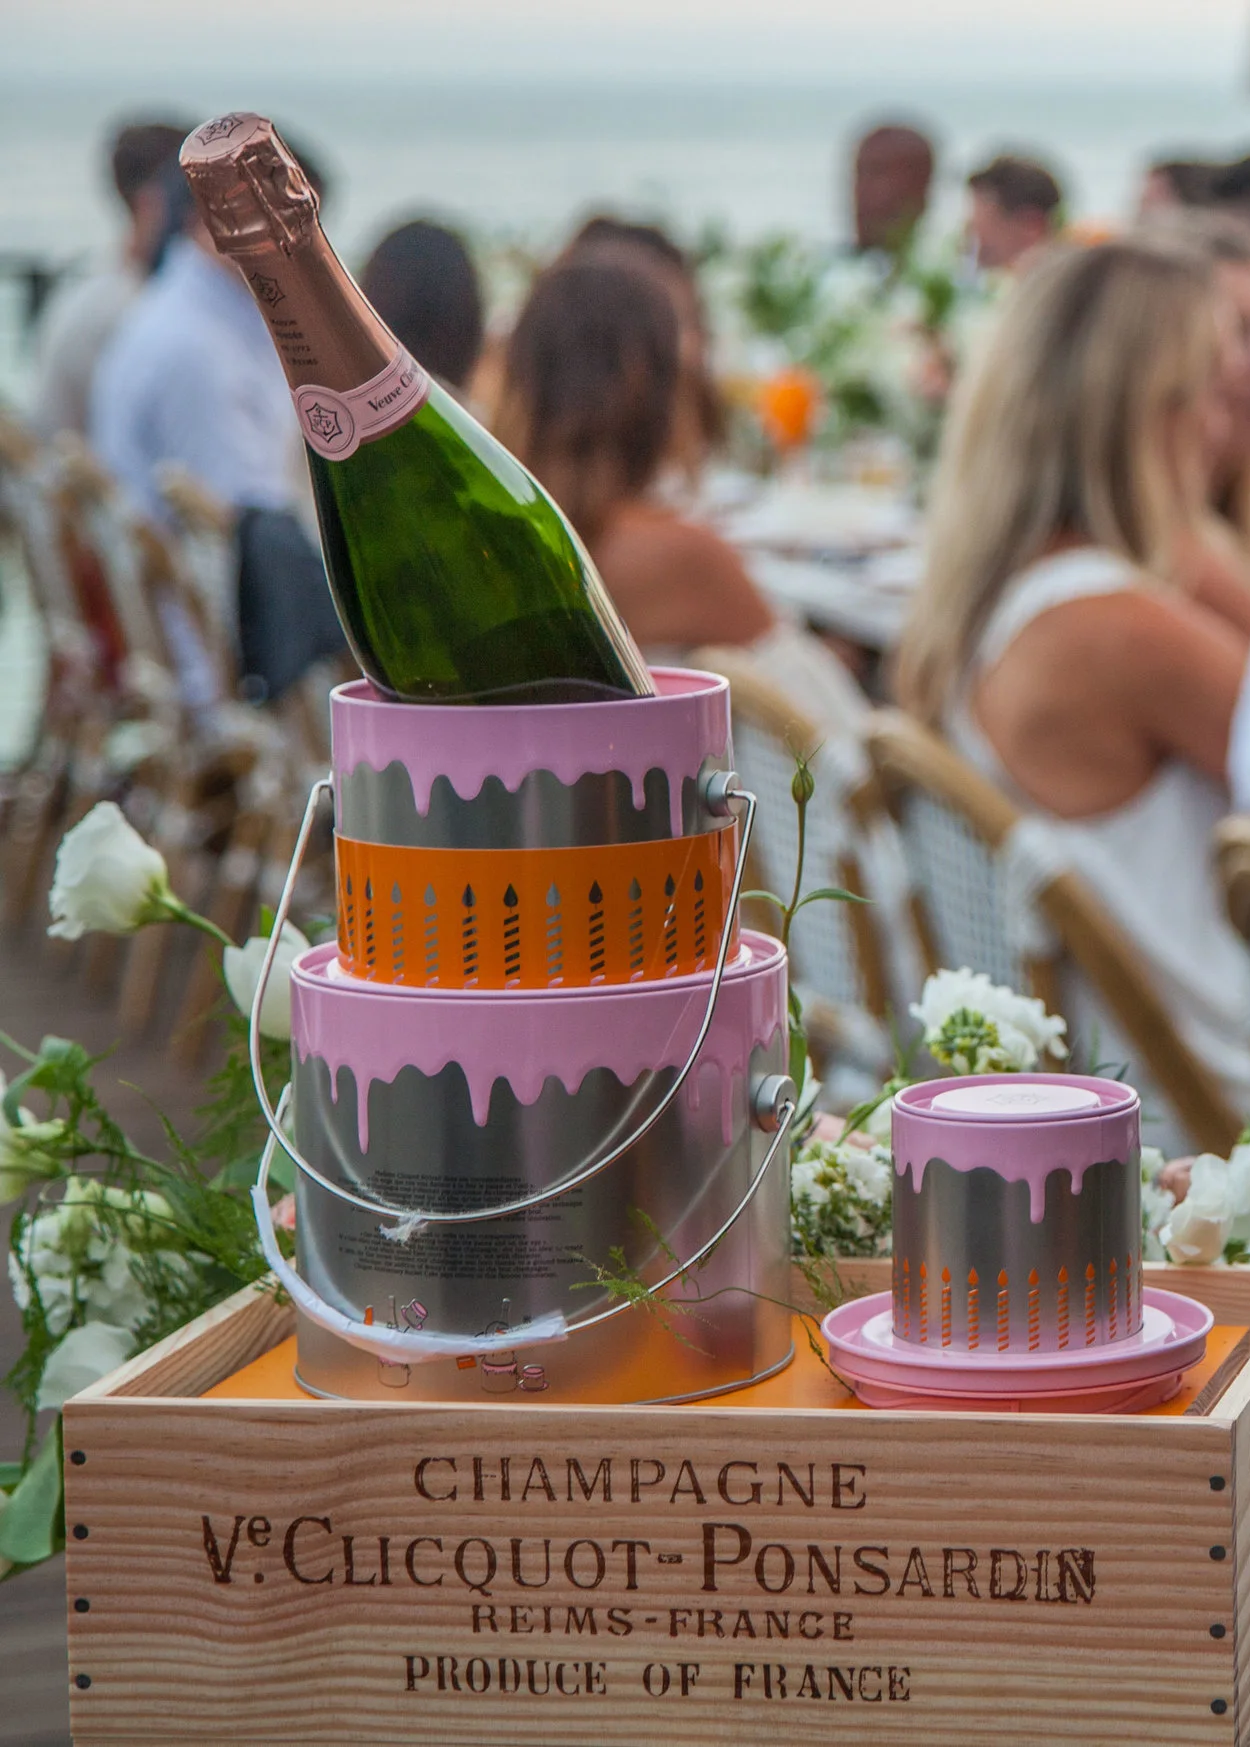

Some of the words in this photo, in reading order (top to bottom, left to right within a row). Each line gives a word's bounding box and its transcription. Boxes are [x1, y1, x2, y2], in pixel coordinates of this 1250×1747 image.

[368, 386, 402, 412] Veuve
[414, 1456, 867, 1510] CHAMPAGNE
[403, 1655, 607, 1696] PRODUCE
[642, 1662, 700, 1697] OF
[734, 1663, 911, 1702] FRANCE
